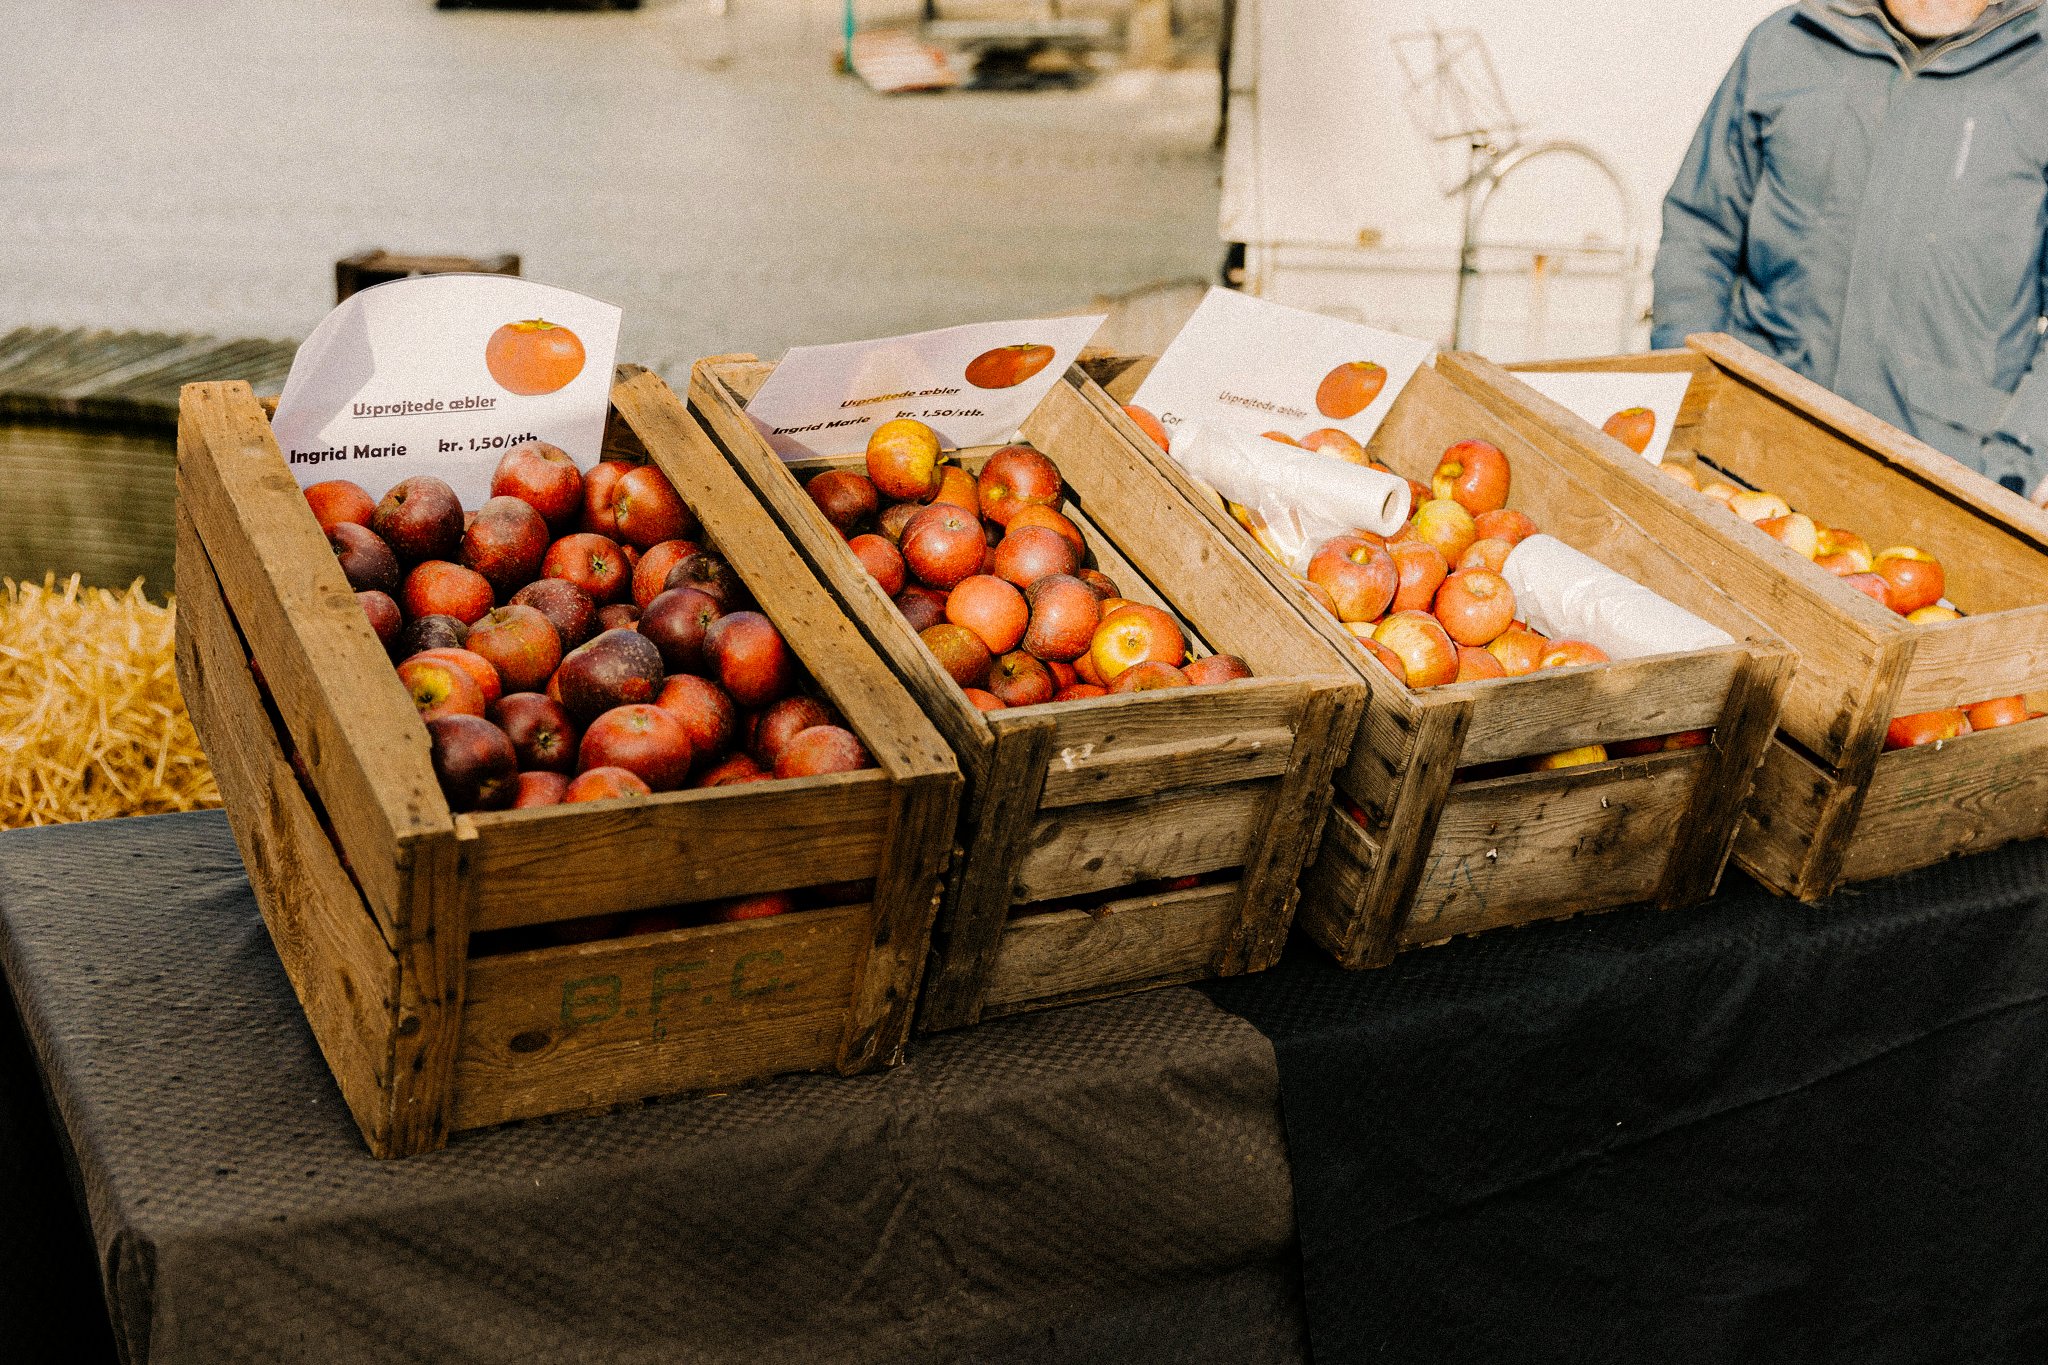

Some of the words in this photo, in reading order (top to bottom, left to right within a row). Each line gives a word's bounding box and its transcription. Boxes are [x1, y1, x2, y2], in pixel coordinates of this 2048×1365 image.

[919, 387, 961, 397] æbler
[353, 398, 444, 417] Usprøjtede
[449, 396, 497, 411] æbler
[772, 422, 824, 436] Ingrid
[825, 415, 872, 429] Marie
[895, 410, 918, 419] kr.
[290, 445, 347, 465] Ingrid
[353, 443, 407, 459] Marie
[438, 438, 464, 453] kr.
